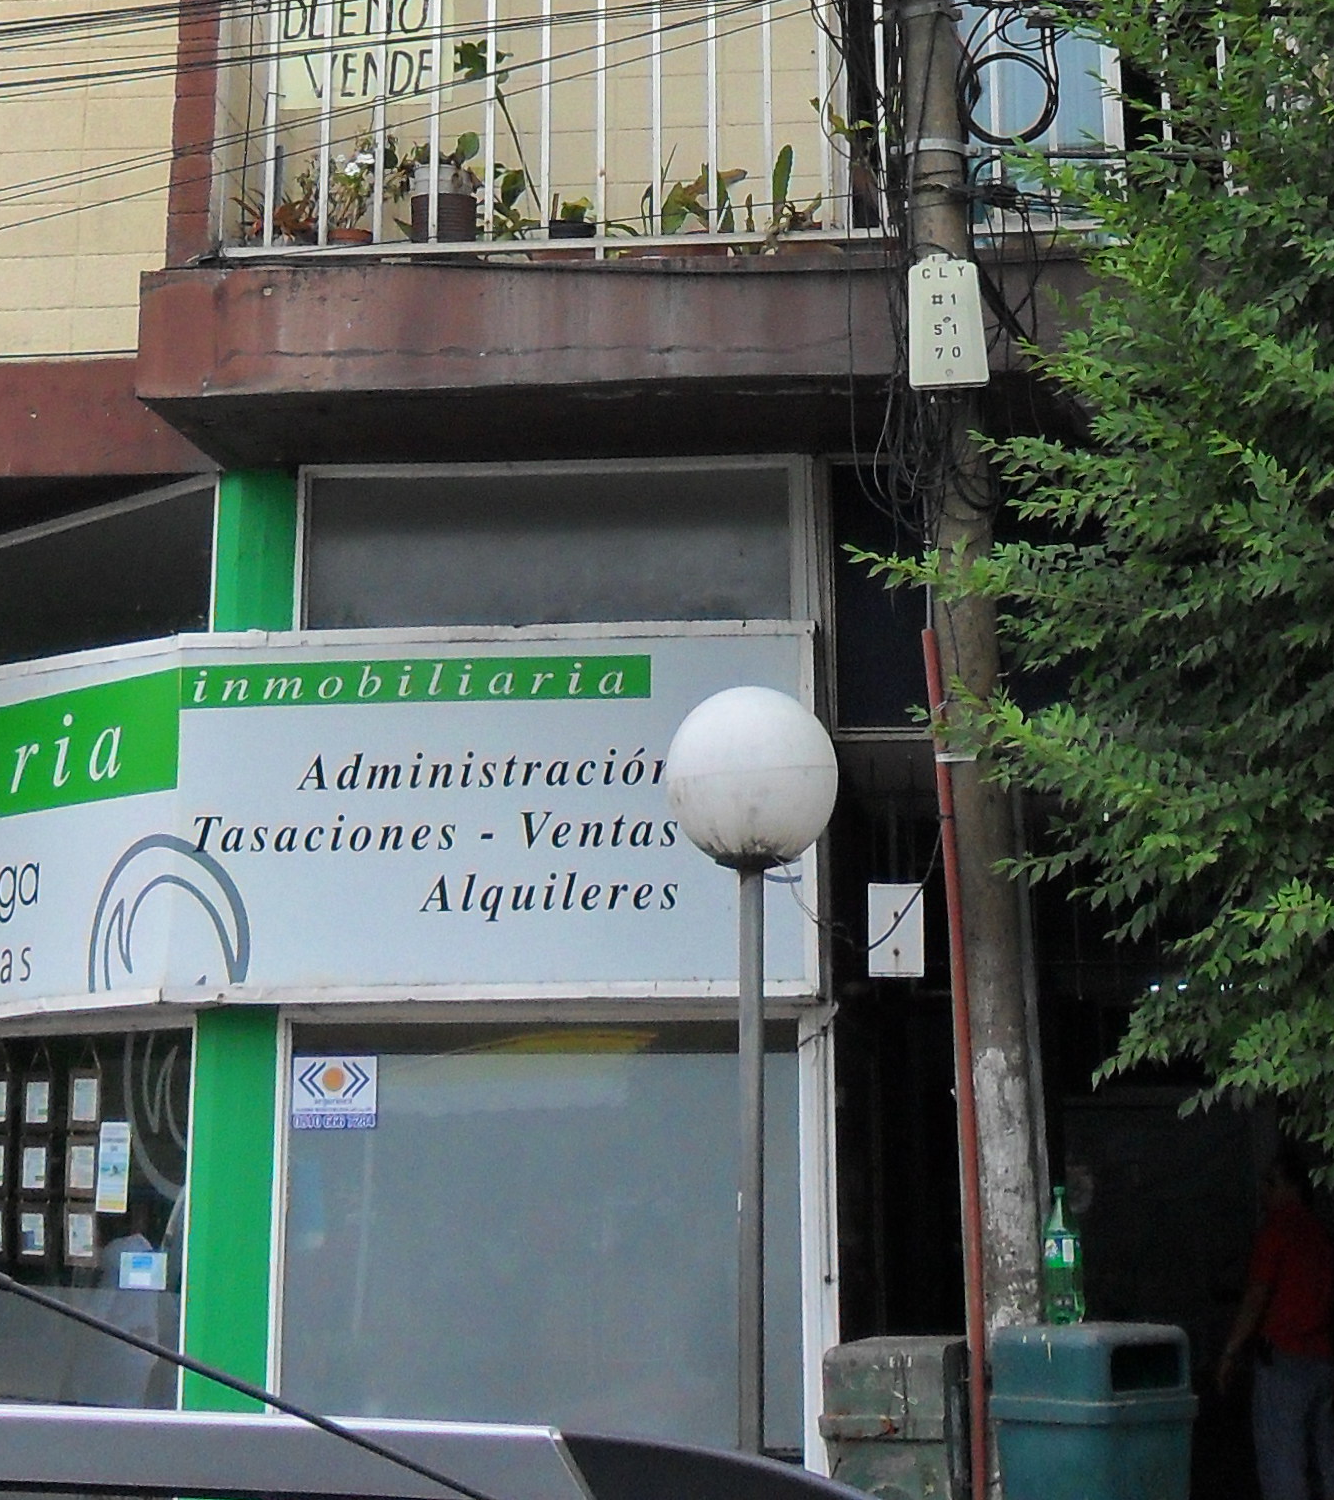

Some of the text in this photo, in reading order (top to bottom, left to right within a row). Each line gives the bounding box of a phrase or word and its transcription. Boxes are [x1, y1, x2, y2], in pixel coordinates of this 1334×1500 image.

[193, 662, 625, 703] inmobiliaria
[191, 813, 457, 854] Tasaciones
[520, 811, 679, 850] Ventas
[418, 871, 679, 923] Alquileres
